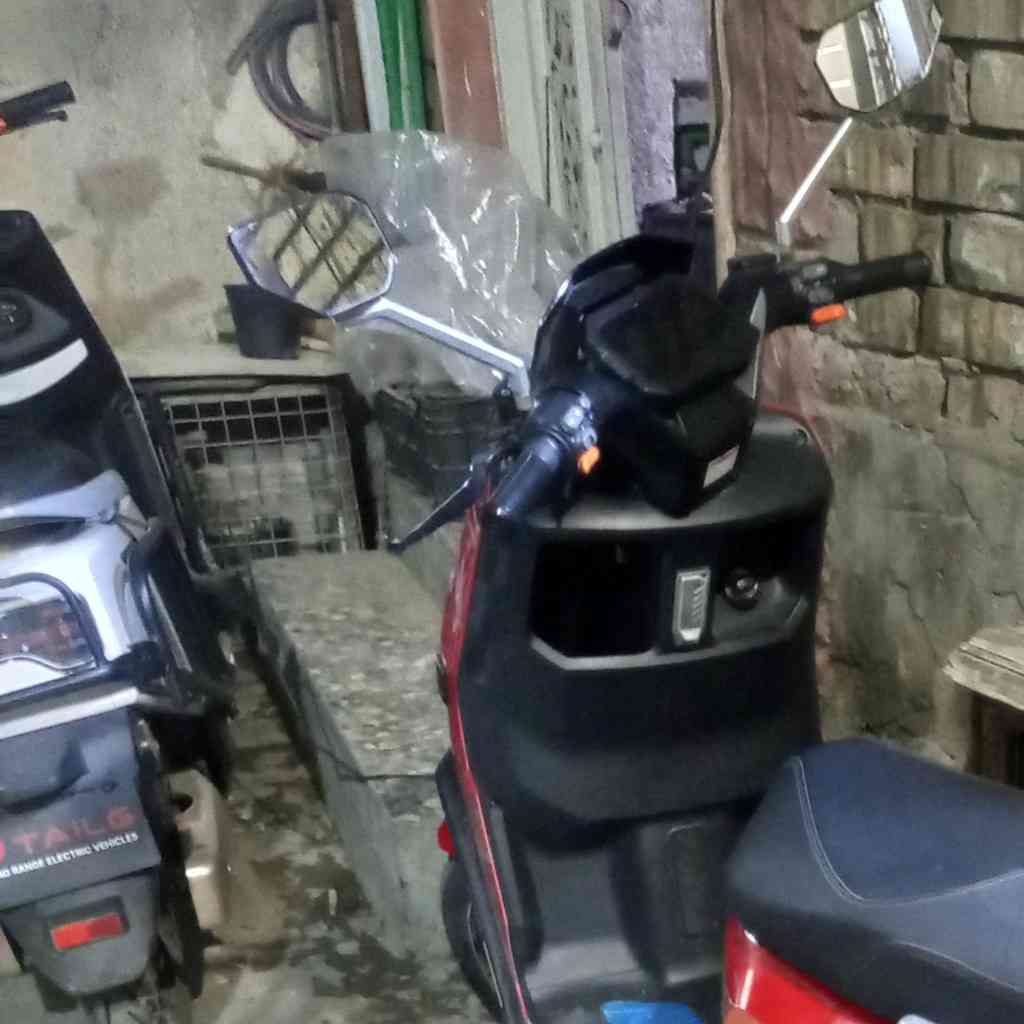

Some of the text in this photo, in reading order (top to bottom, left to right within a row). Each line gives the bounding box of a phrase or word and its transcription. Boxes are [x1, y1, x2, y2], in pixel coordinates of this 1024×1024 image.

[10, 858, 45, 876] RANGE
[46, 845, 93, 867] ELECTRIC
[93, 832, 139, 853] VEHICLES
